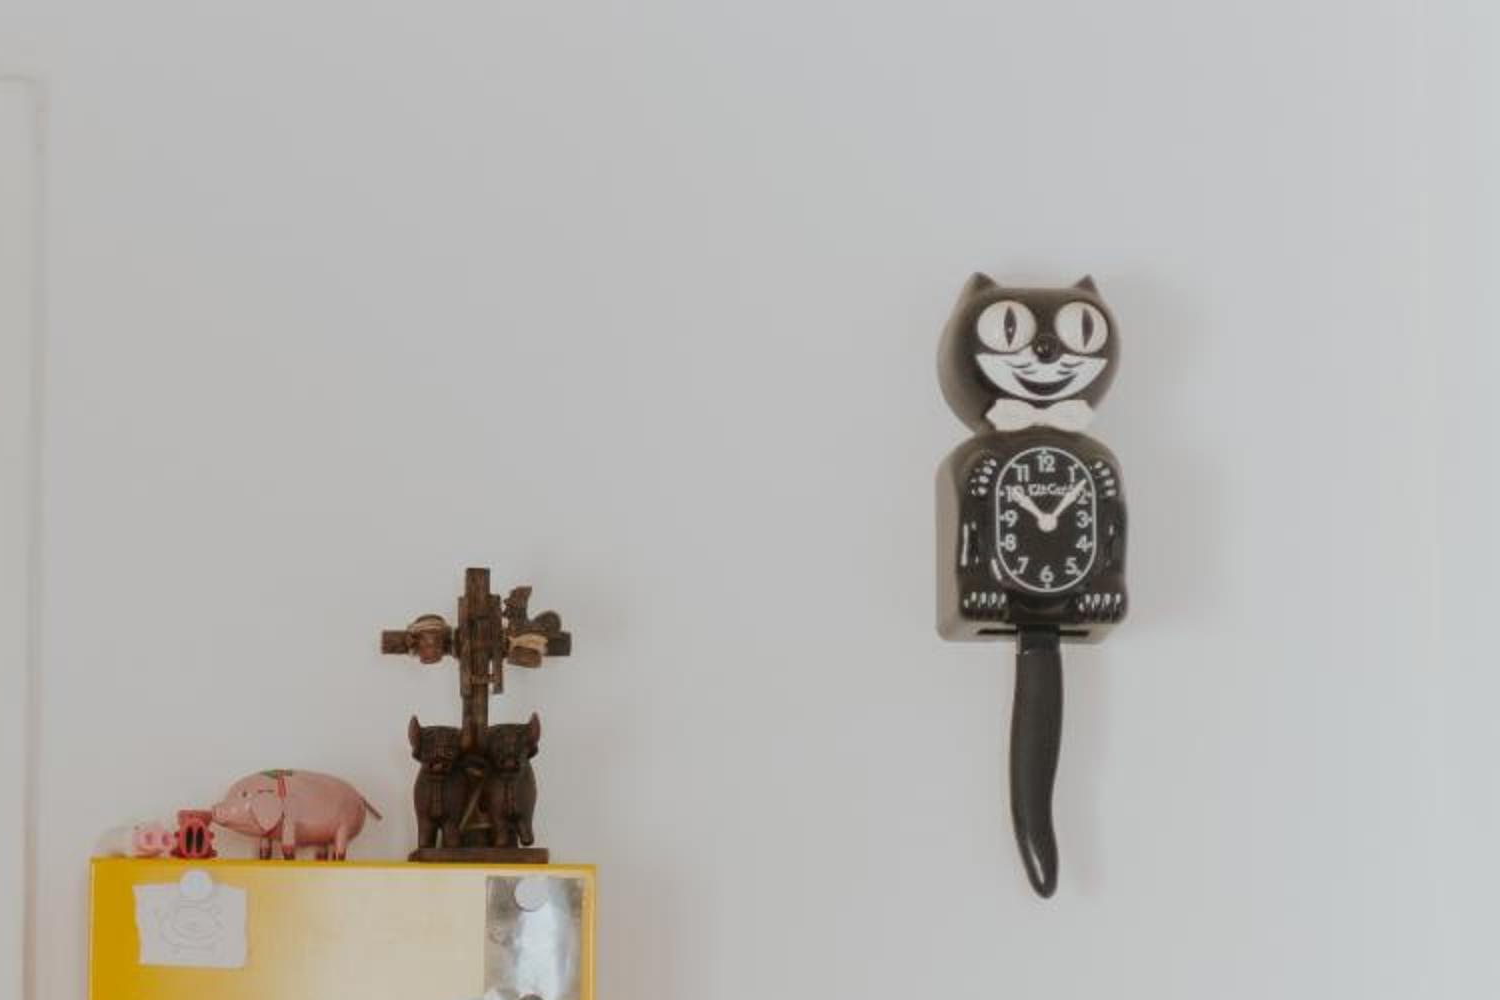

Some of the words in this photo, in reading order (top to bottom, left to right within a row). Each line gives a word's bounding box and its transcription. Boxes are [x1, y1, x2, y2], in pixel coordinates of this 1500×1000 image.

[1013, 464, 1029, 482] 11
[1036, 454, 1056, 473] 12
[1004, 509, 1018, 528] 9
[1076, 510, 1089, 529] 3
[1005, 533, 1016, 552] 8
[1076, 535, 1088, 553] 4
[1017, 557, 1029, 574] 7
[1040, 565, 1054, 584] 6
[1065, 557, 1078, 575] 5
